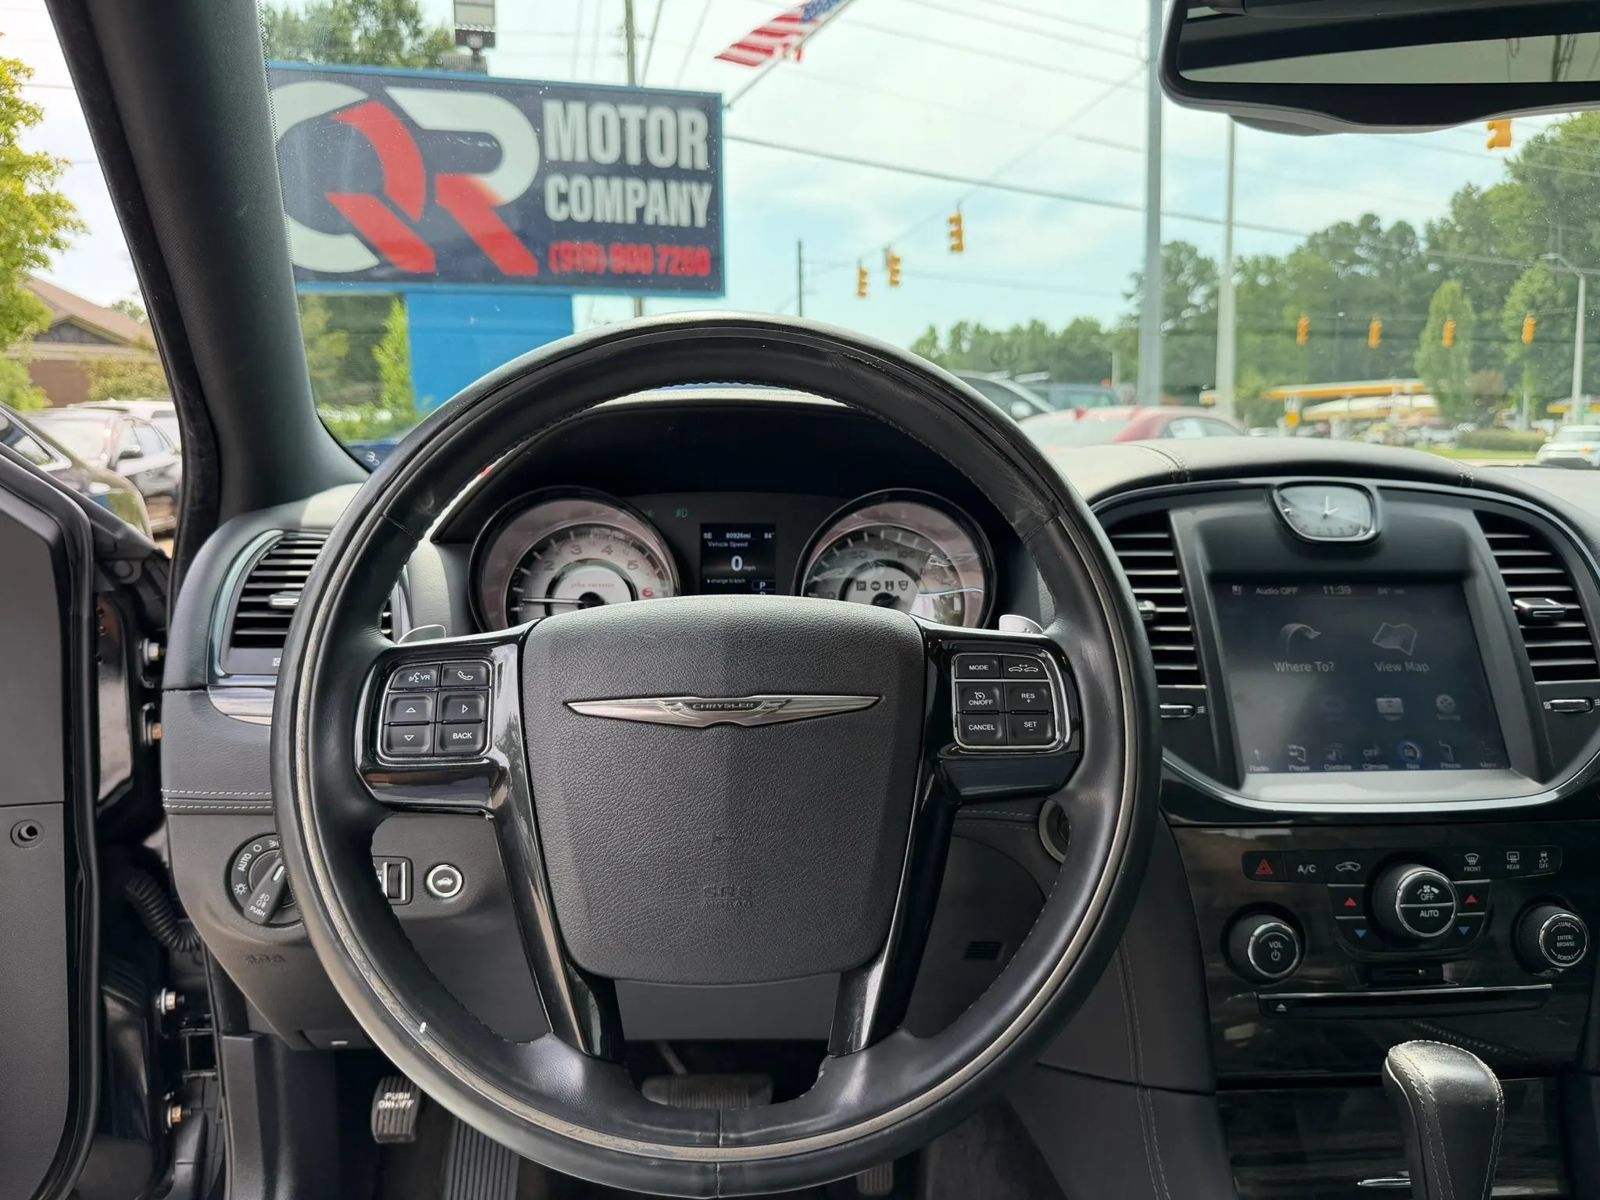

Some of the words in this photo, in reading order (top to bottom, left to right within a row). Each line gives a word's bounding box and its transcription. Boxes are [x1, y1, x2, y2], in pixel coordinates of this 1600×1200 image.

[543, 99, 709, 171] MOTOR
[544, 173, 713, 229] COMPANY
[571, 544, 582, 555] 3
[601, 544, 613, 555] 4
[729, 541, 749, 549] Speed
[543, 559, 555, 571] 2
[627, 559, 639, 570] 5
[730, 555, 743, 572] 0
[759, 581, 767, 589] P
[1255, 586, 1279, 595] Audio
[1280, 586, 1298, 595] OFF
[642, 587, 654, 598] 6
[1273, 661, 1312, 673] Where
[1314, 661, 1335, 673] To?
[1374, 661, 1401, 673] View
[1405, 661, 1430, 675] Map
[691, 702, 754, 710] CHRYSLER
[452, 732, 473, 740] BACK
[237, 853, 252, 872] AUTO
[1297, 864, 1317, 874] A/C
[248, 905, 266, 917] PUSH
[1419, 909, 1440, 917] AUTO
[1268, 941, 1283, 949] VOL
